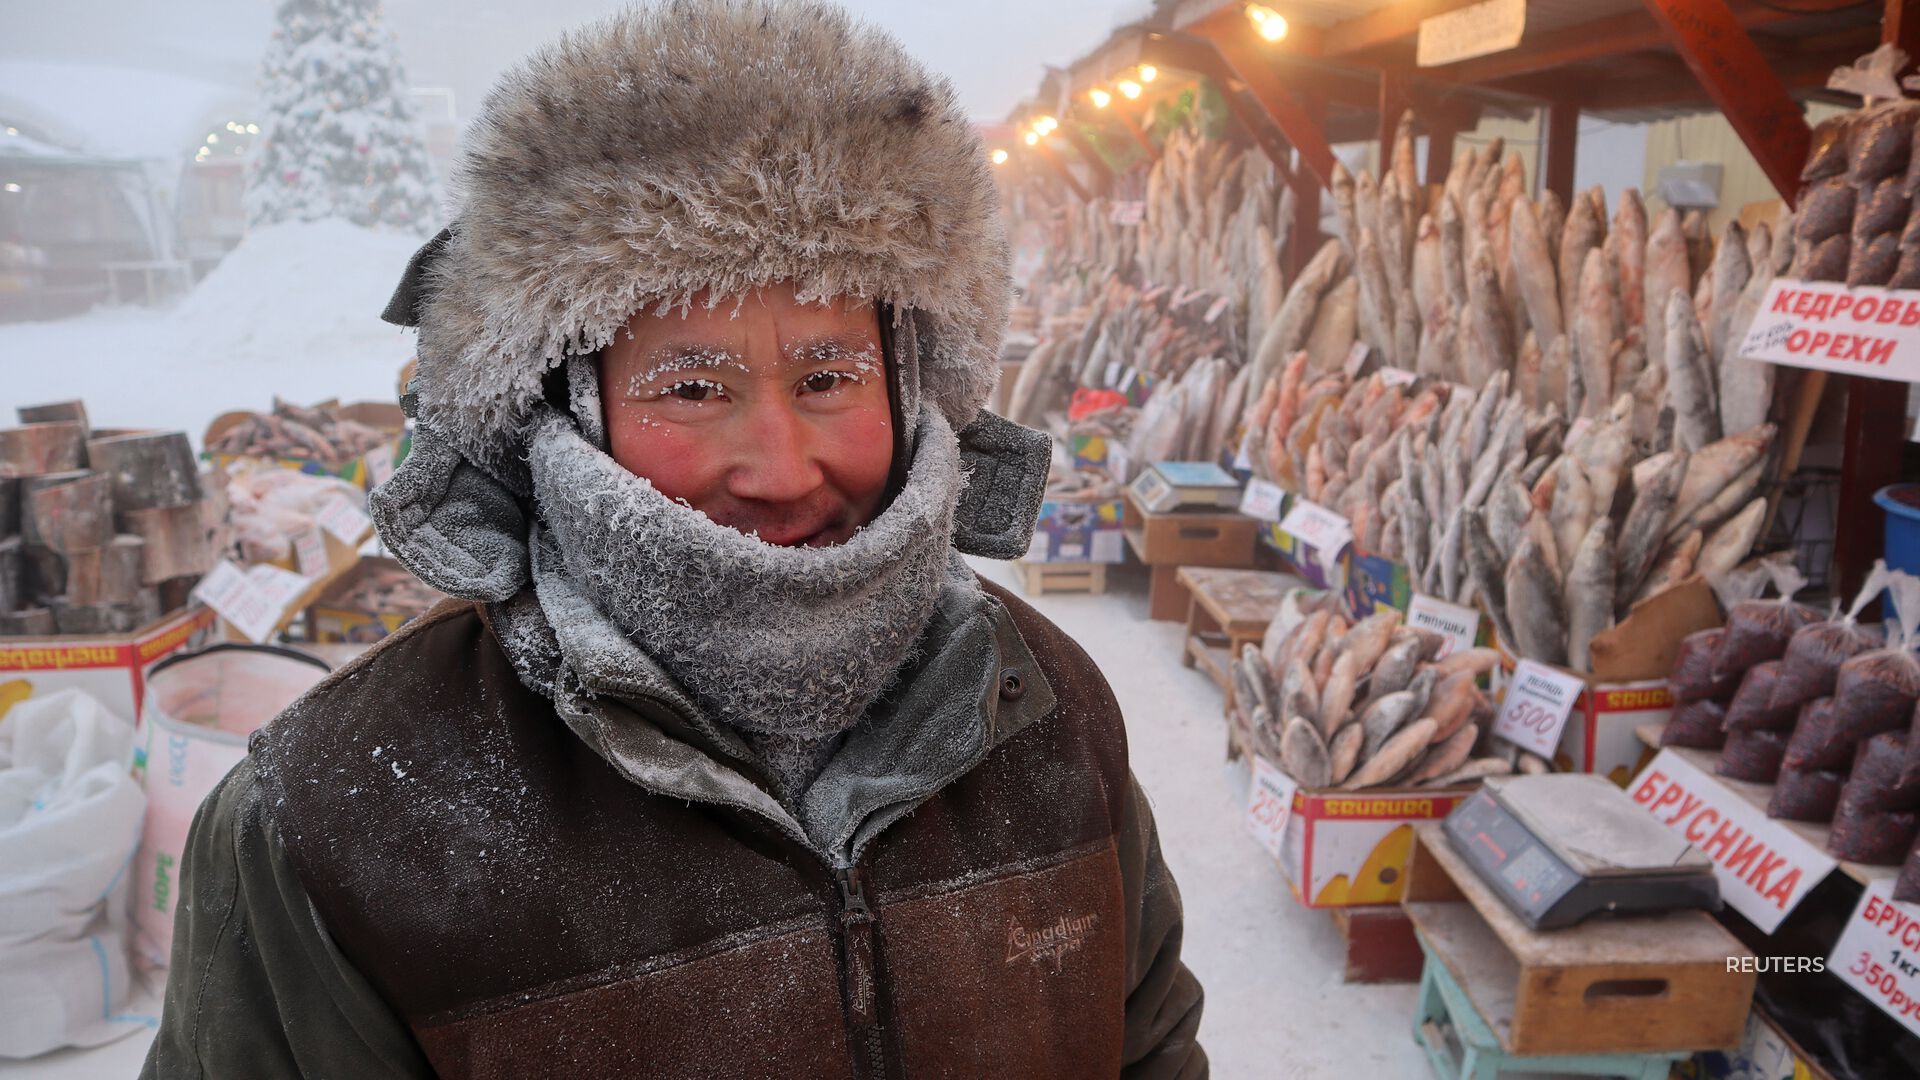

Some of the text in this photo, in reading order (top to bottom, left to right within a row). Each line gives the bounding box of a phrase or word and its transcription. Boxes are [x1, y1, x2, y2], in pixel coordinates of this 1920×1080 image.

[1786, 328, 1898, 365] ОРЕХИ
[1507, 699, 1557, 736] 500
[1324, 798, 1433, 817] bananas
[1633, 770, 1803, 910] БРУСНИКА
[1863, 895, 1920, 953] БРУС
